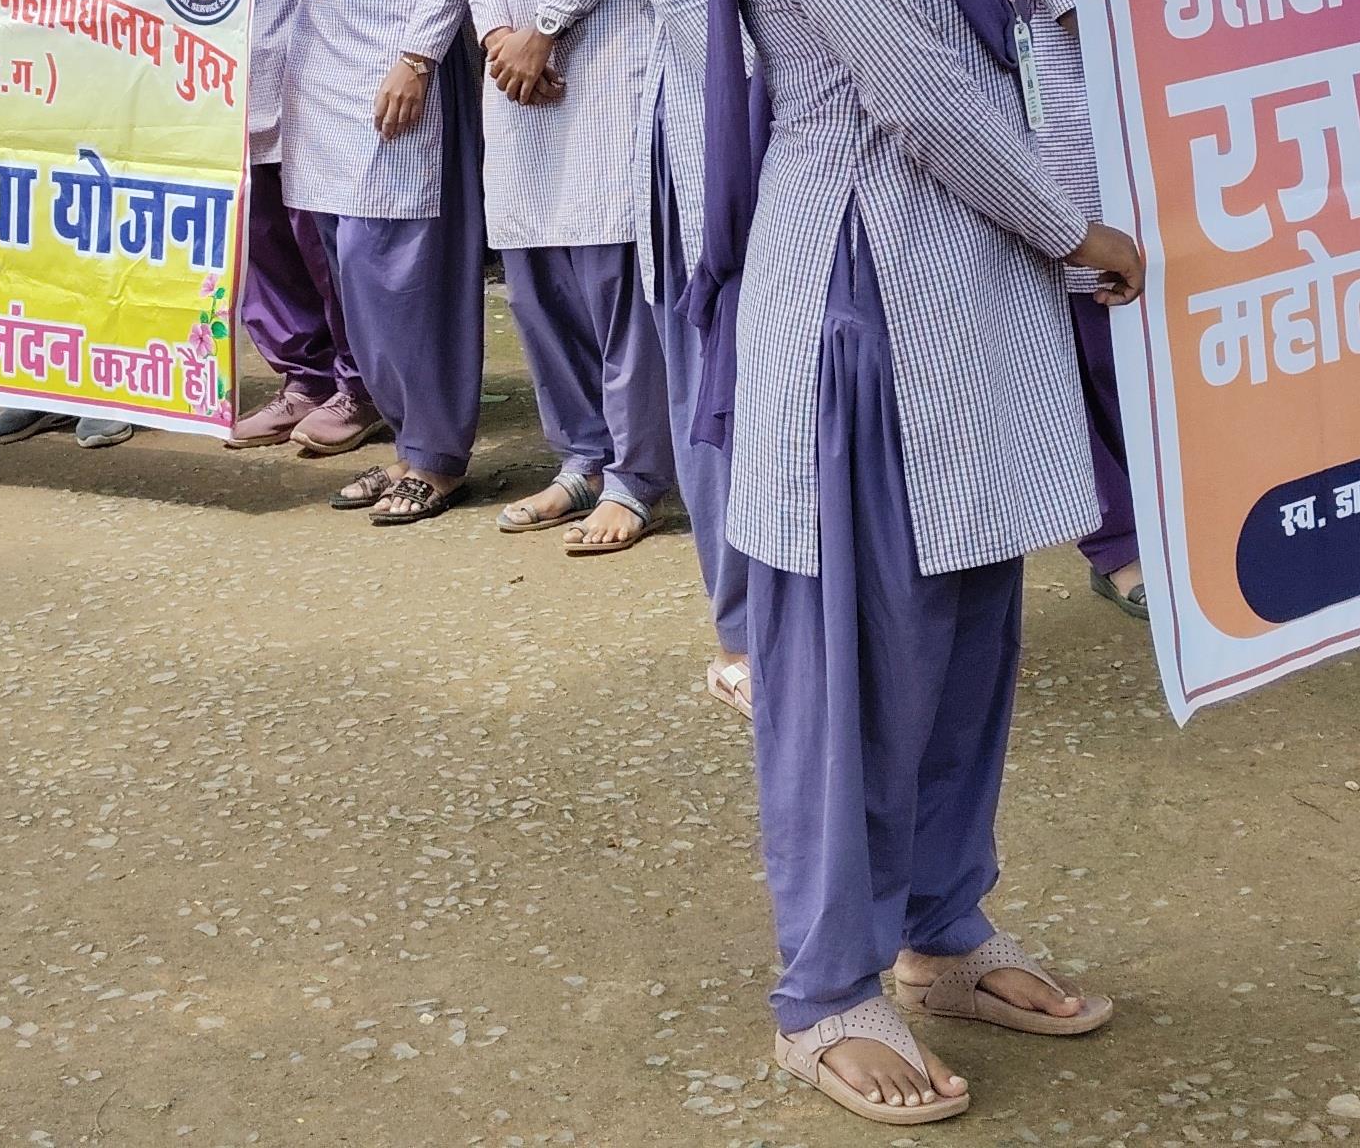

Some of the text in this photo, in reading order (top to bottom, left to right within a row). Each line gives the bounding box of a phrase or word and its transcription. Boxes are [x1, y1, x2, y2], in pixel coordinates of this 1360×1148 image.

[52, 149, 235, 269] योजना
[91, 343, 174, 397] करती
[1280, 495, 1327, 537] स्व.
